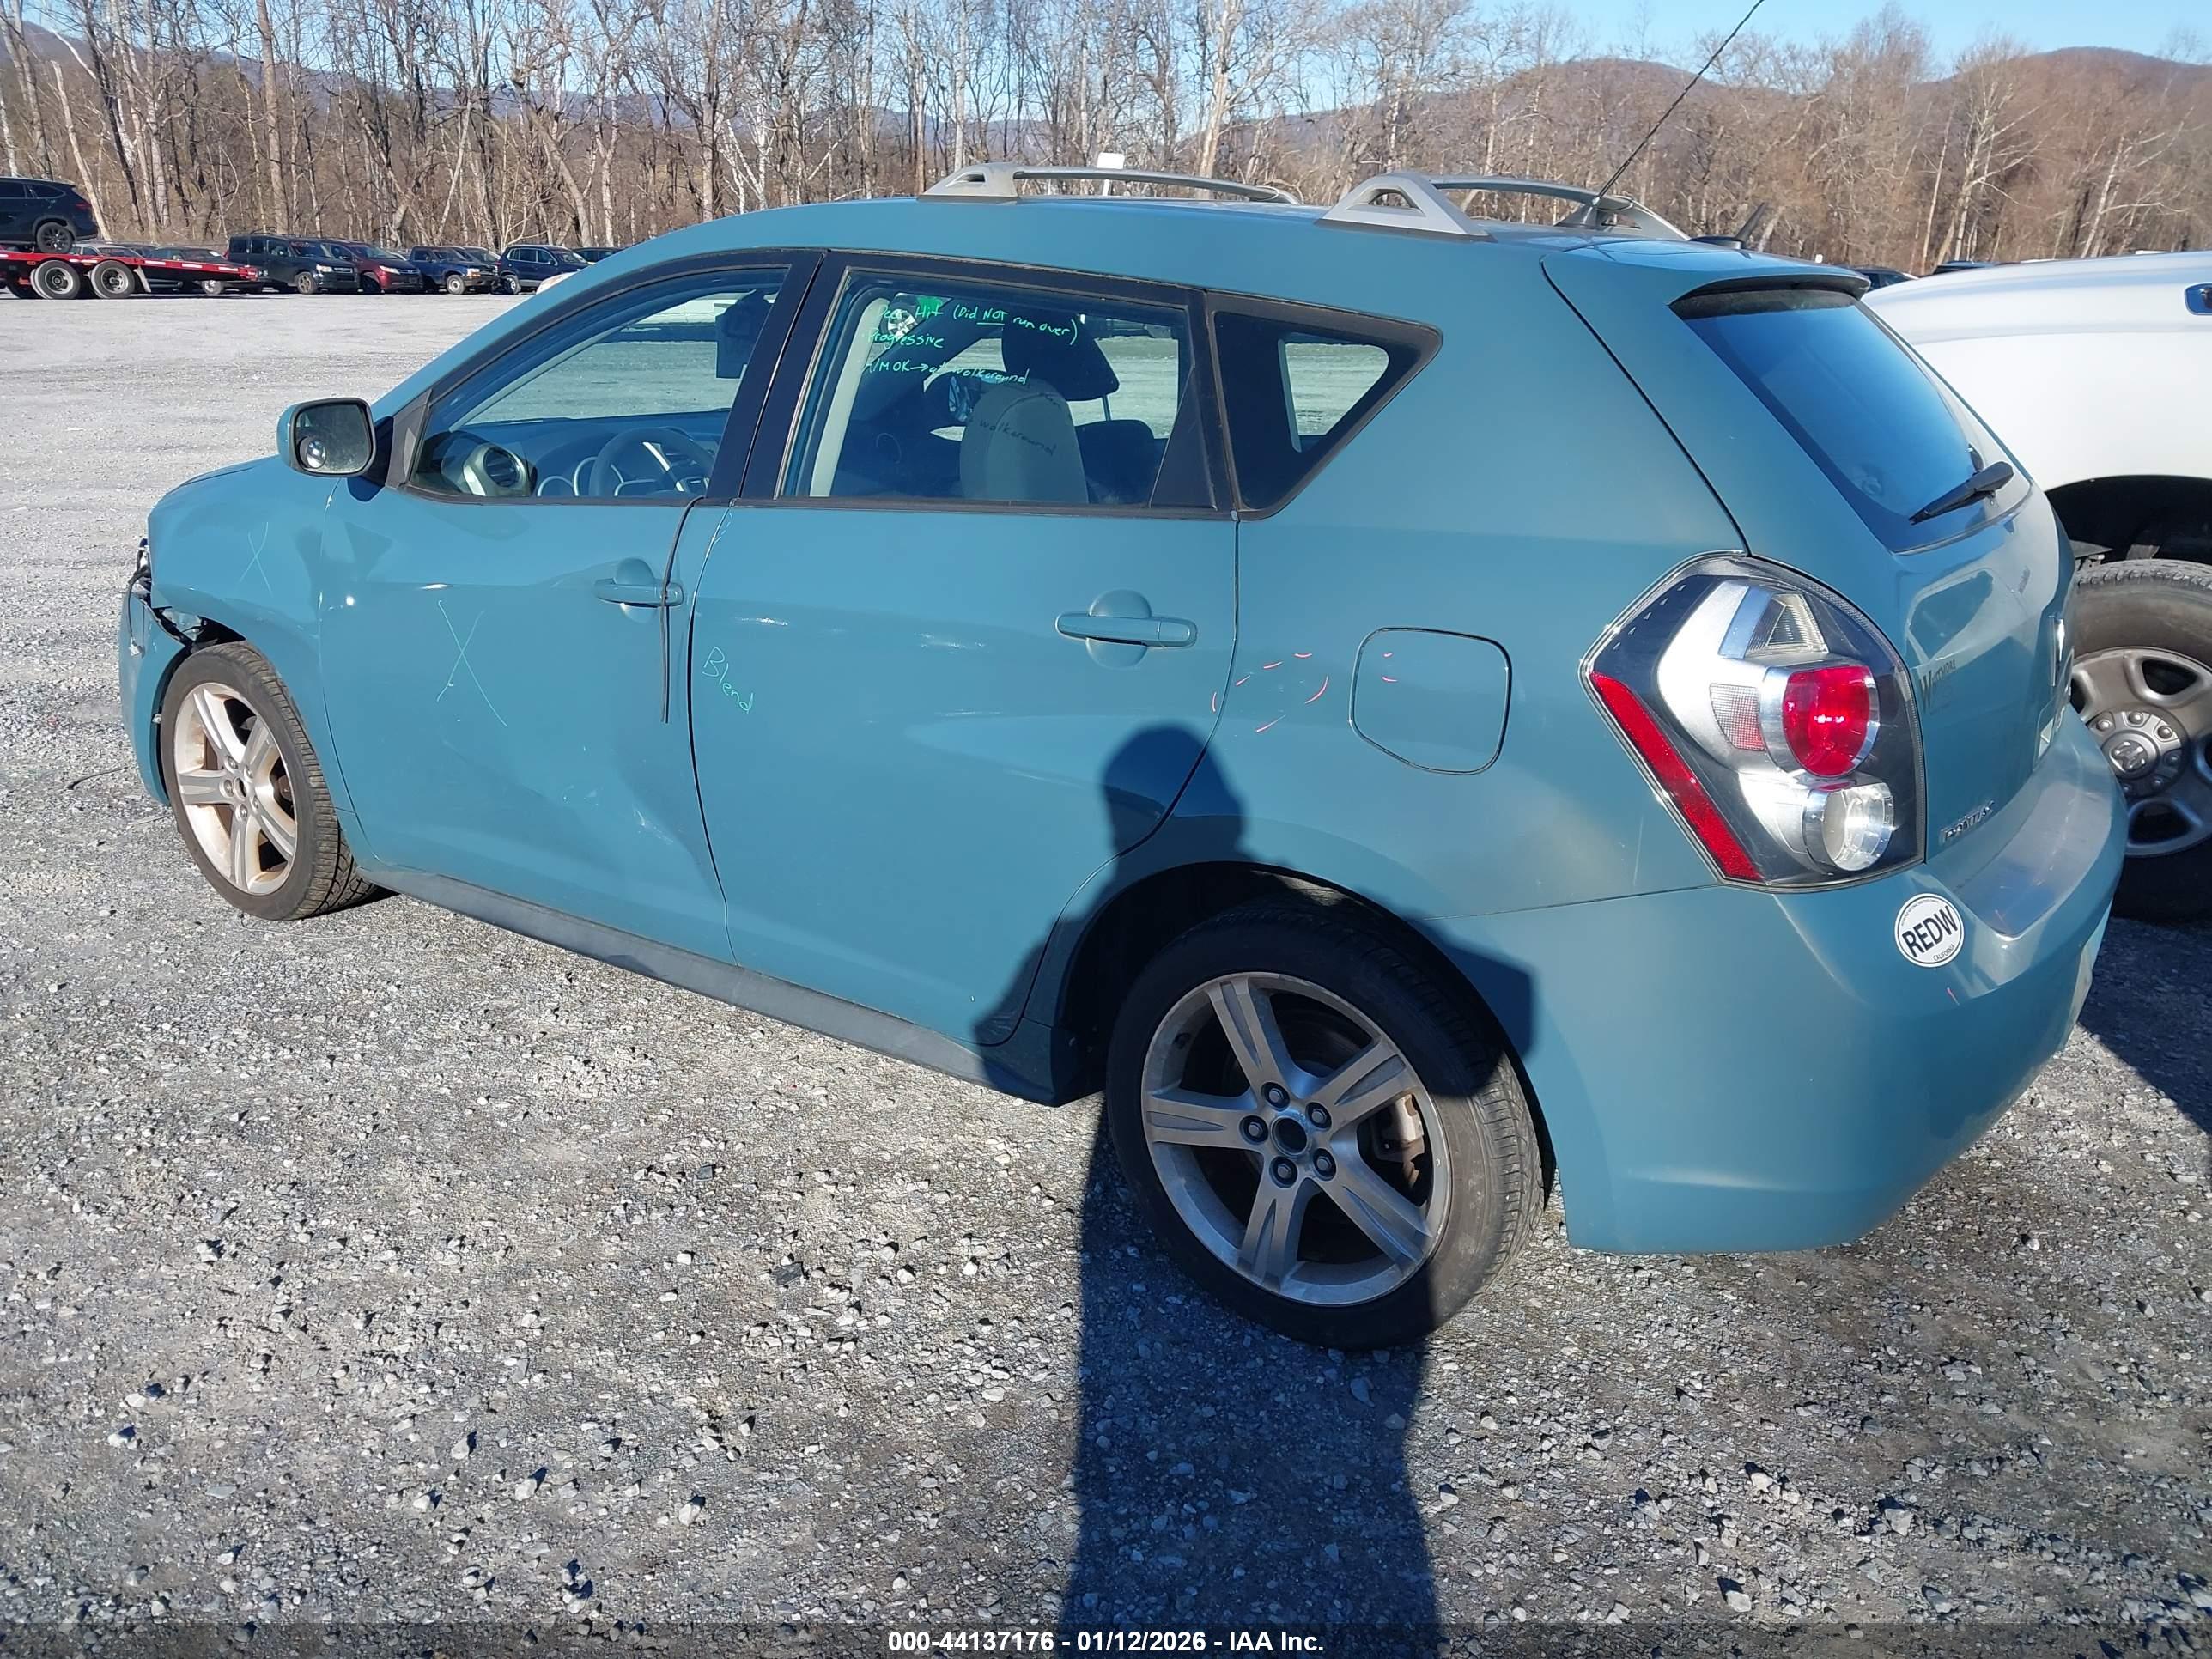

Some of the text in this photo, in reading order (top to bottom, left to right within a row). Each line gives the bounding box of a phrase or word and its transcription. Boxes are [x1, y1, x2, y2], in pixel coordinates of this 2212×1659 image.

[915, 304, 944, 319] Hit
[953, 304, 978, 319] (Did
[982, 307, 1009, 321] NOT
[1013, 316, 1035, 328] run
[868, 328, 945, 350] Progressive
[892, 360, 910, 371] OK
[702, 646, 754, 714] Blend
[1901, 905, 1958, 958] REDW
